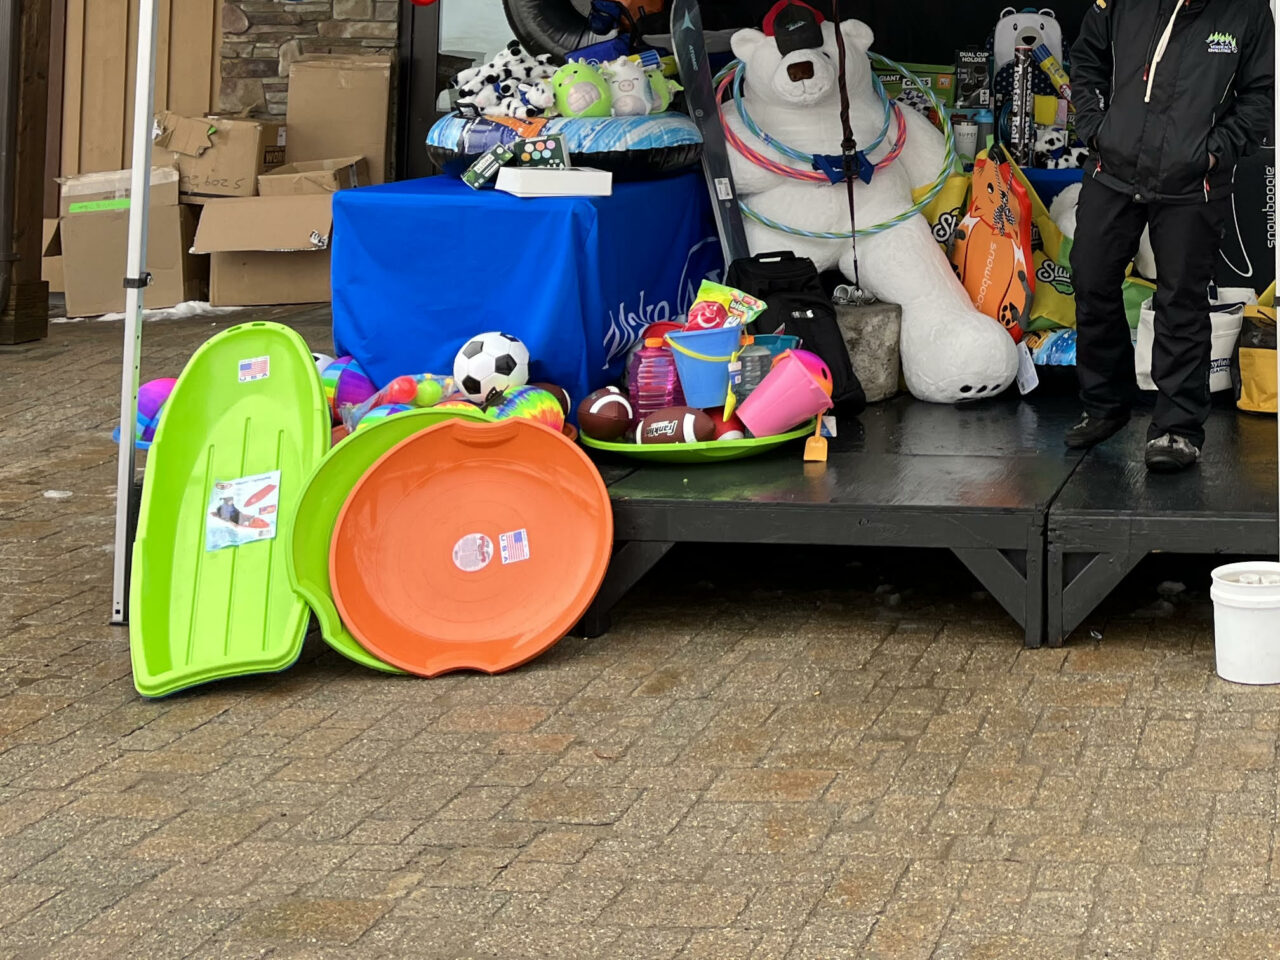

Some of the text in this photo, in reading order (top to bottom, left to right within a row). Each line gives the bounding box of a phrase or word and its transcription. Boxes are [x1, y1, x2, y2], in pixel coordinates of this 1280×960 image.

[688, 44, 700, 72] ATOMIC
[878, 74, 901, 82] GIANT
[1010, 64, 1023, 144] Tootsie Roll
[1262, 166, 1276, 249] snowboogie
